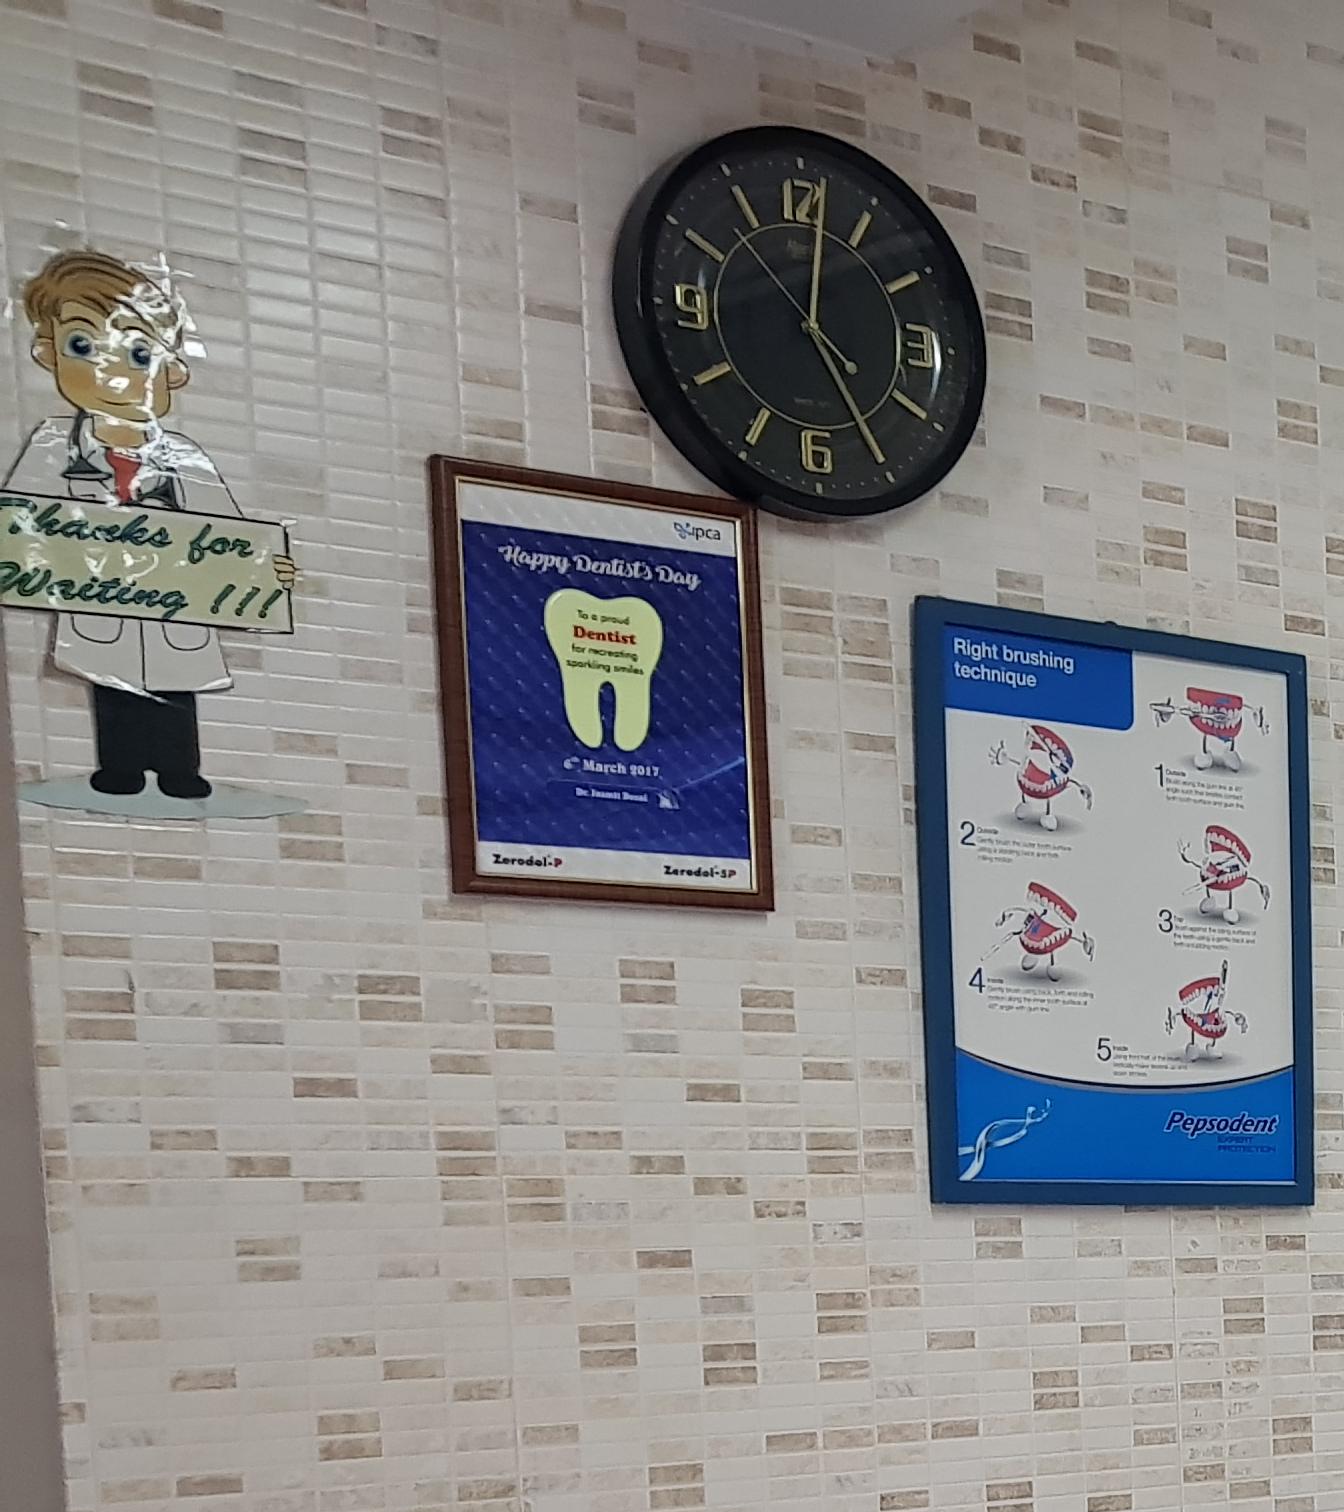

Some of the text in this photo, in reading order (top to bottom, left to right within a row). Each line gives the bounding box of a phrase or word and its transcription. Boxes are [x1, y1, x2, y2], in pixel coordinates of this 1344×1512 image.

[782, 177, 823, 224] 12
[675, 283, 708, 330] 9
[905, 322, 935, 369] 3
[801, 429, 833, 474] 6
[187, 522, 254, 564] for
[498, 545, 702, 592] Happy Dentist's Day
[0, 561, 188, 619] Waiting
[577, 608, 589, 620] To
[600, 615, 630, 626] proud
[571, 642, 586, 653] for
[572, 624, 637, 645] Dentist
[953, 637, 1075, 674] Right brushing
[953, 661, 1038, 688] technique
[583, 759, 627, 775] March
[629, 764, 660, 777] 2017
[1154, 763, 1164, 788] 1
[960, 820, 976, 846] 2
[1158, 908, 1173, 933] 3
[968, 966, 986, 994] 4
[1096, 1037, 1112, 1062] 5
[1163, 1109, 1280, 1139] Pepsodent
